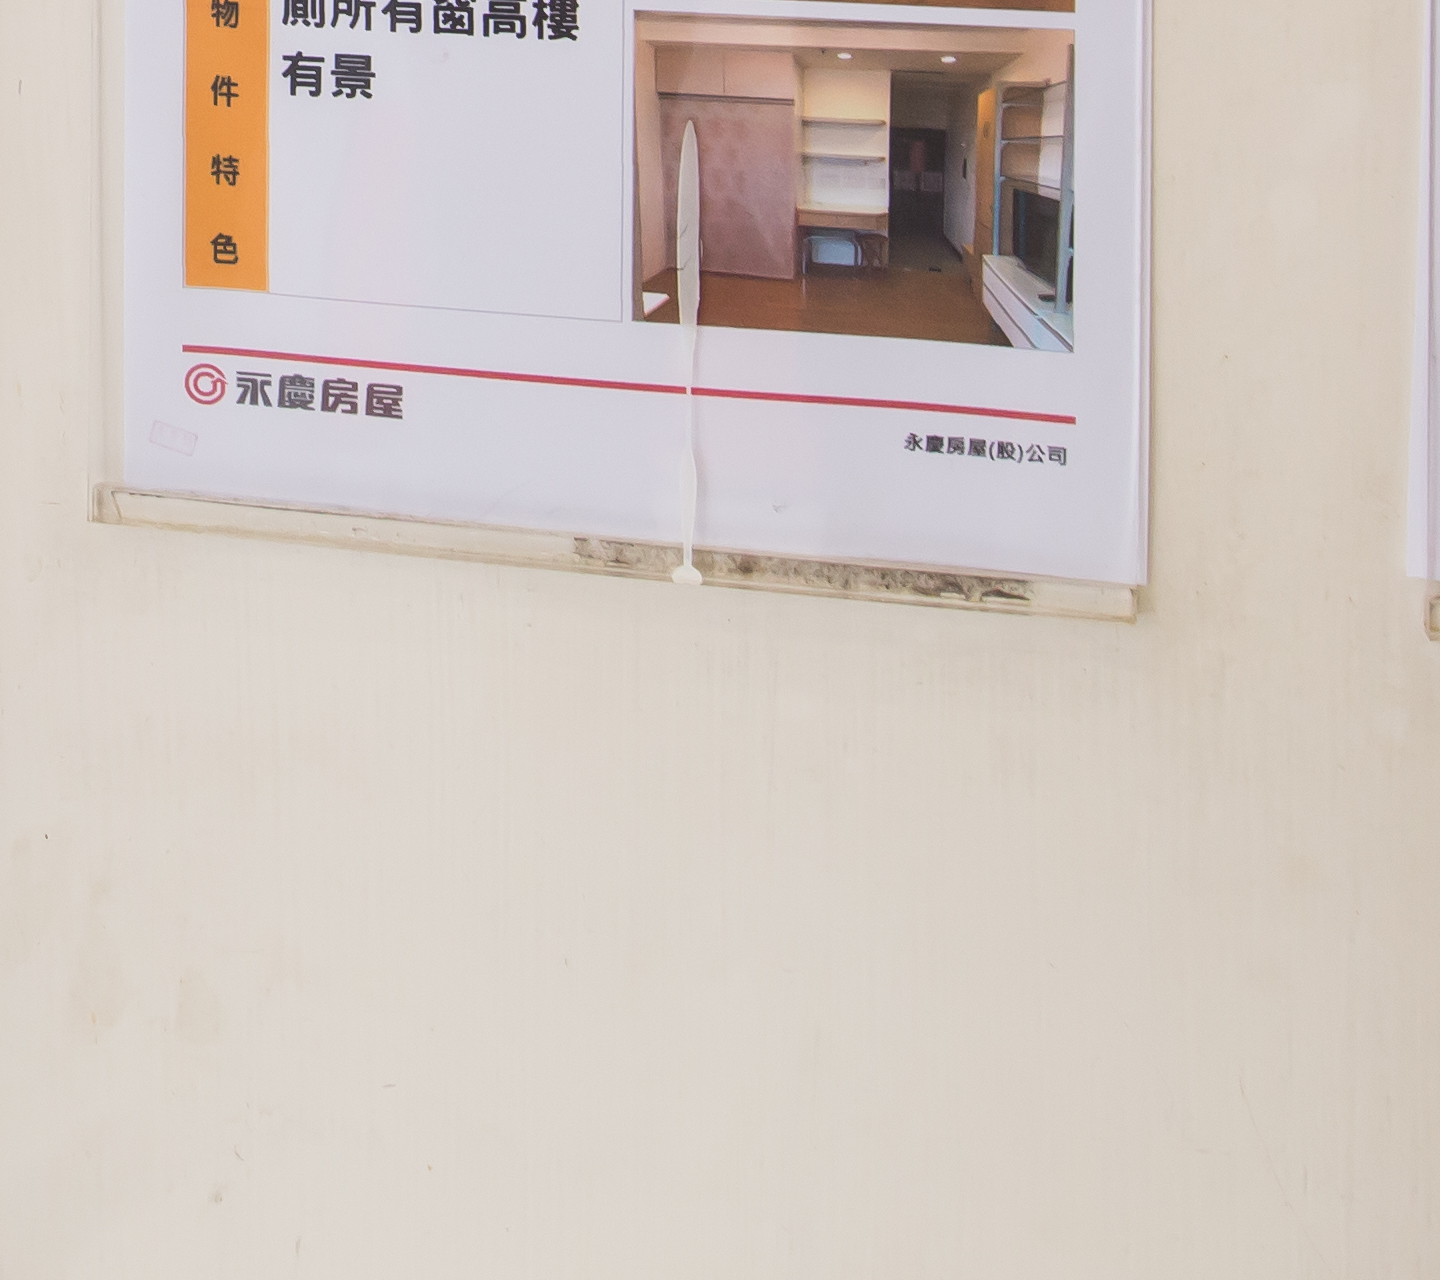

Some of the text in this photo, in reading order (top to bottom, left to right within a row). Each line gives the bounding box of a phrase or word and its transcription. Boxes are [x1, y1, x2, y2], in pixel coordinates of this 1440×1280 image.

[281, 50, 376, 100] 有景
[236, 370, 404, 420] 永慶房屋
